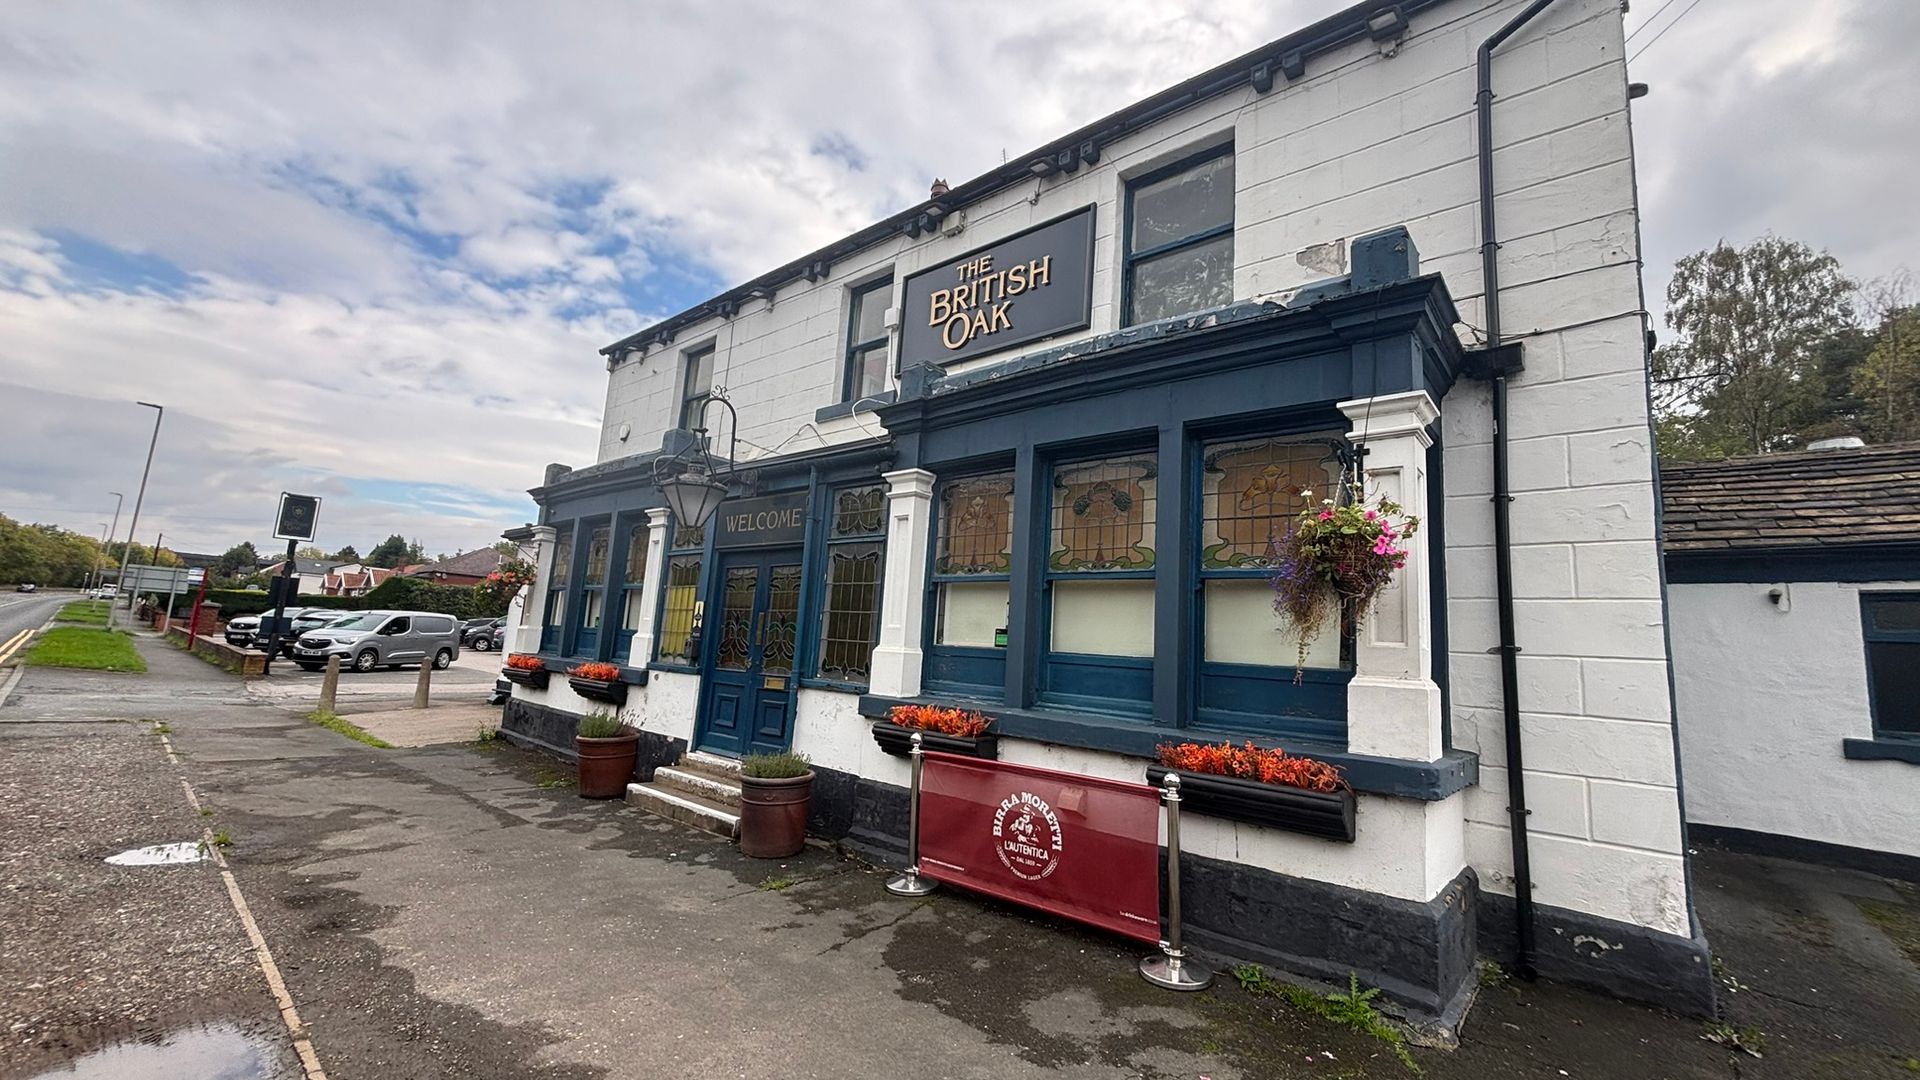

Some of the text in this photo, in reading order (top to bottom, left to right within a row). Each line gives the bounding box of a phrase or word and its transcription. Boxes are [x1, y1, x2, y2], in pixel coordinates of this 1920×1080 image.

[956, 255, 993, 281] THE
[928, 255, 1050, 326] BRITISH
[943, 300, 1012, 349] OAK
[726, 508, 802, 532] WELCOME
[993, 792, 1062, 851] BIRRA MORETTI
[1004, 840, 1049, 860] L'AUTENTICA
